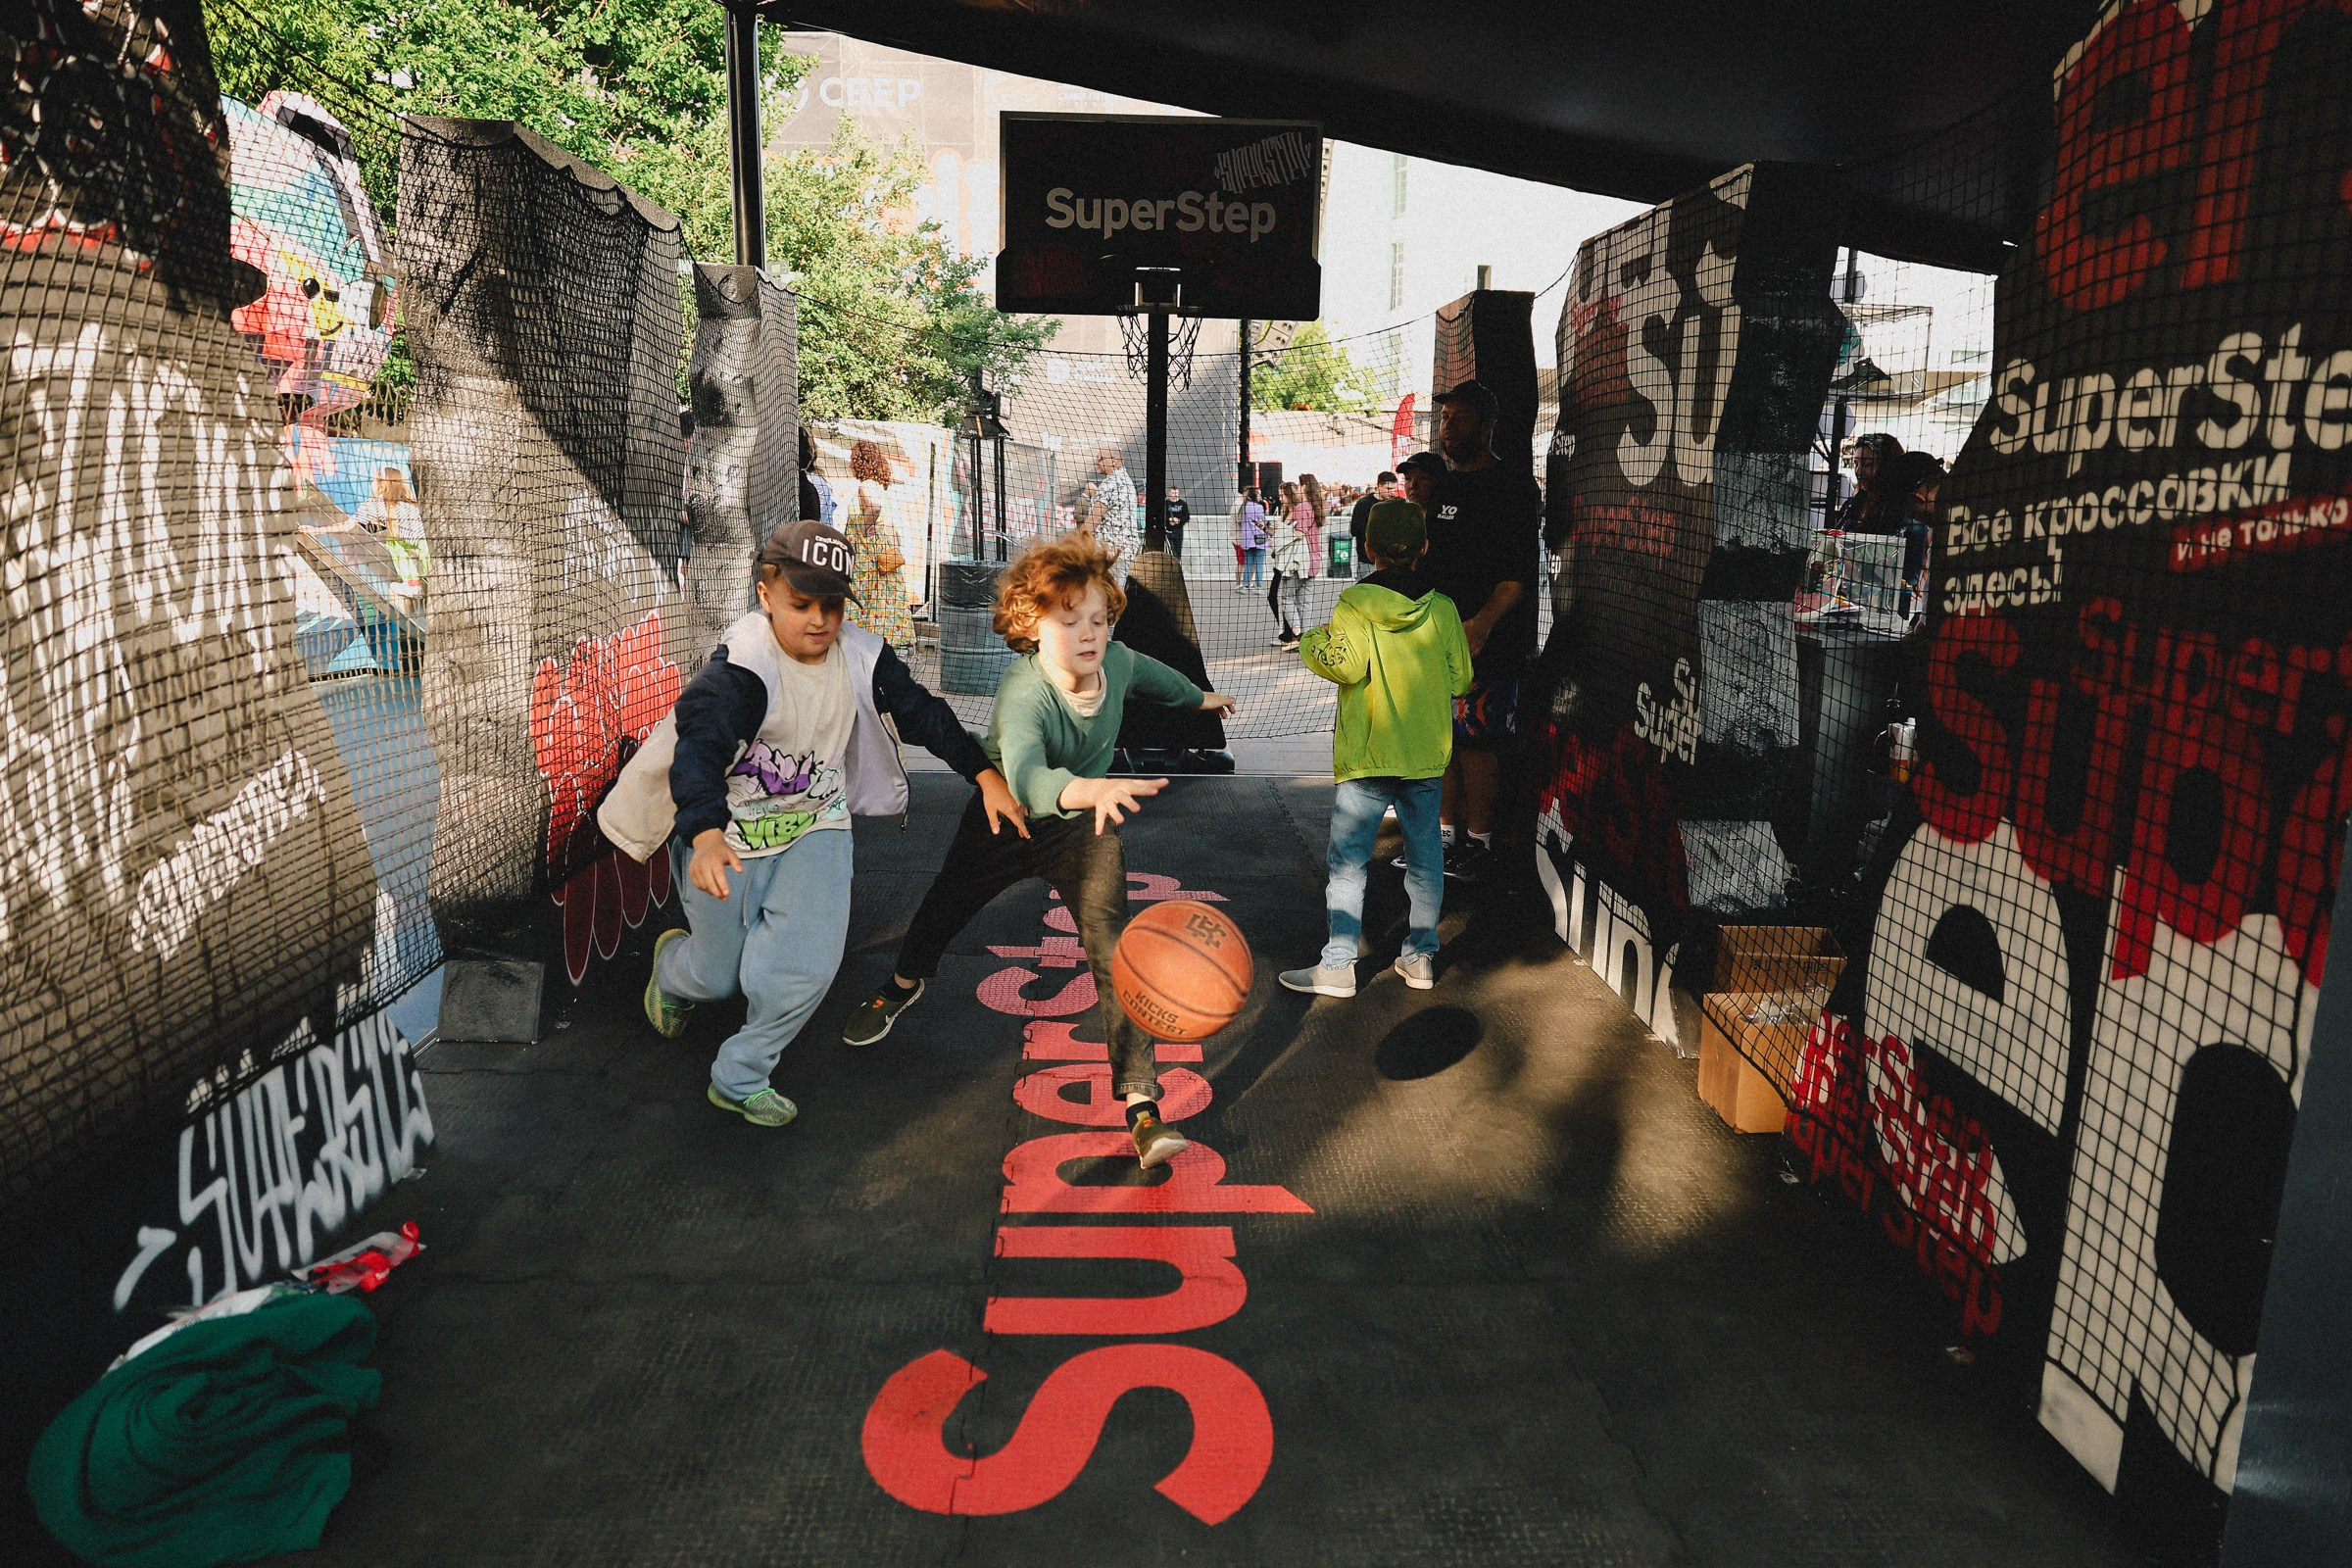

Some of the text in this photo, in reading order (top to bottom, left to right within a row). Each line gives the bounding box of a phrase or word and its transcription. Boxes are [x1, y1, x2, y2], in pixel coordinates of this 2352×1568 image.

[1045, 186, 1277, 244] SuperStep
[1442, 505, 1458, 515] YO
[1945, 451, 2292, 557] Все кроссовки
[802, 538, 855, 579] ICON
[1122, 989, 1189, 1036] CONTEST
[1135, 990, 1180, 1024] KICKS
